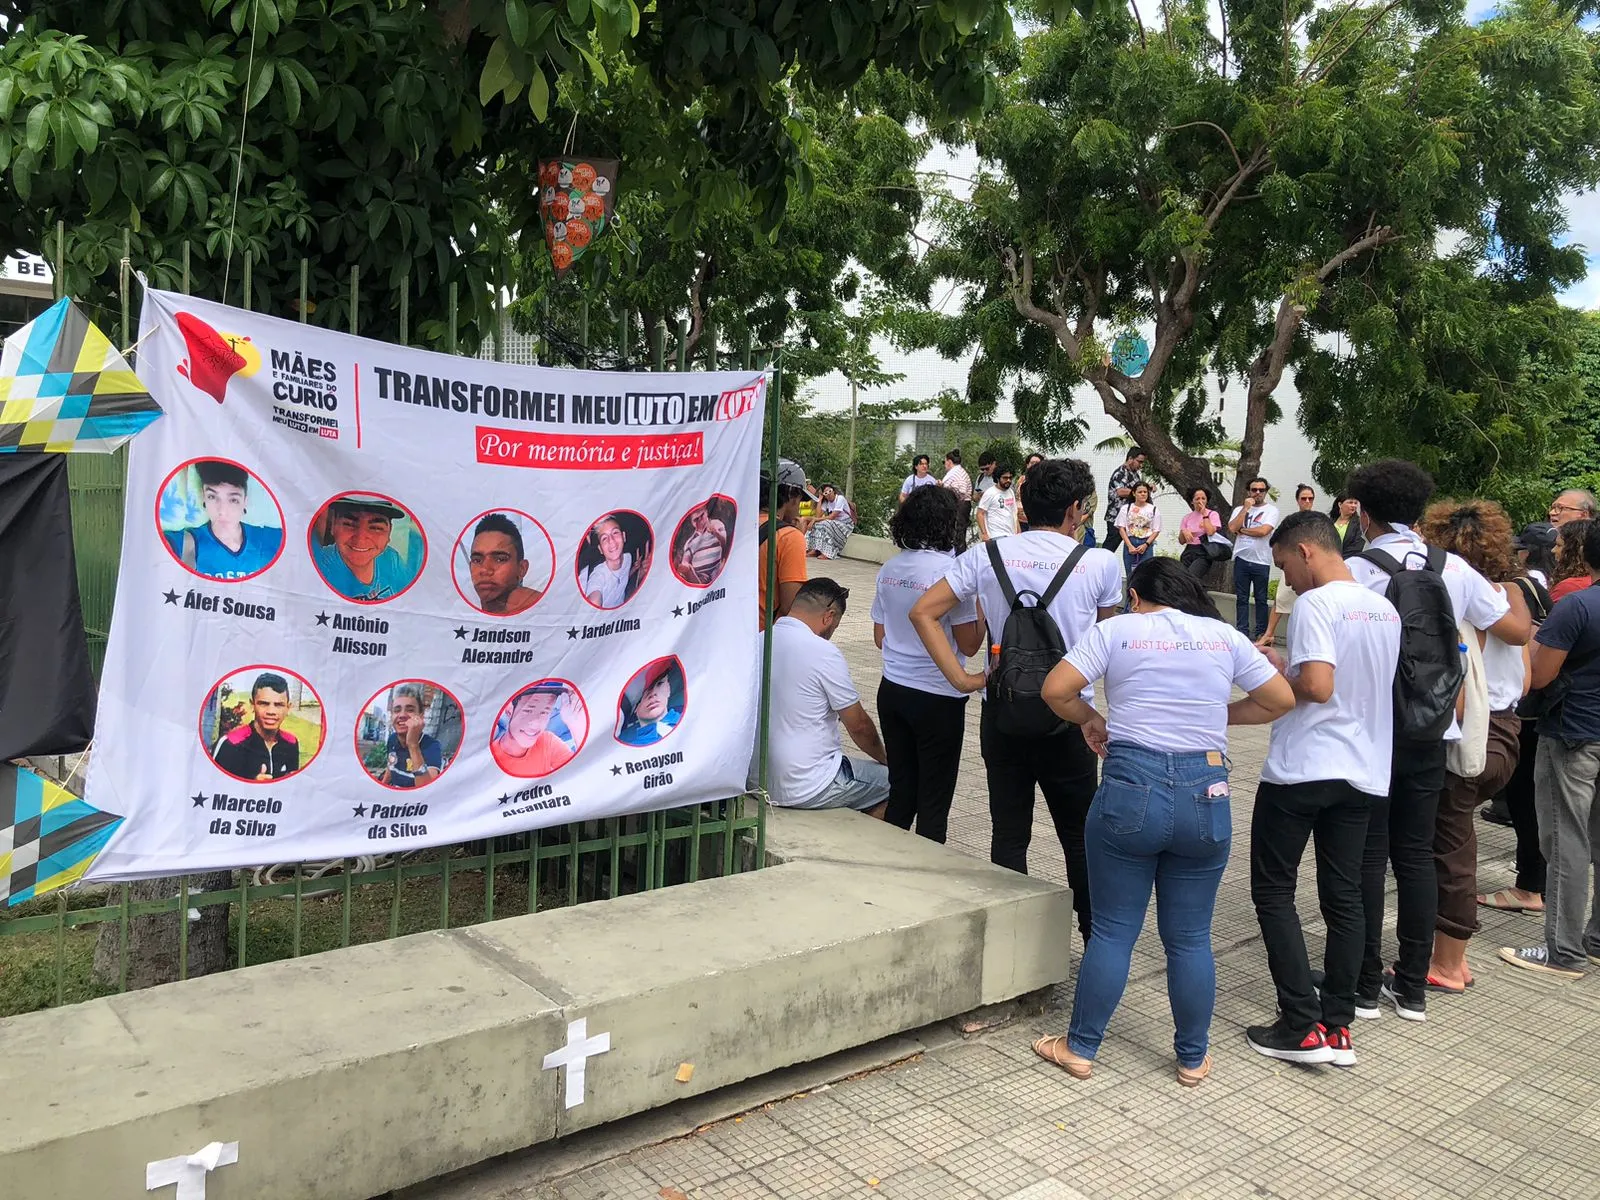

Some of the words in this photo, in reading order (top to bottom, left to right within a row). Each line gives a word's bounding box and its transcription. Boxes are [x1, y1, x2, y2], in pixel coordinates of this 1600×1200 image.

[271, 349, 336, 382] MÃES
[272, 371, 278, 379] E
[281, 373, 324, 390] FAMILIARES
[326, 383, 337, 392] DO
[374, 367, 565, 423] TRANSFORMEI
[572, 395, 622, 425] MEU
[626, 395, 684, 425] LUTO
[687, 395, 719, 424] EM
[272, 415, 287, 425] MEU
[289, 419, 307, 432] LUTO
[308, 426, 319, 434] EM
[320, 428, 338, 438] LUTA
[273, 405, 338, 428] TRANSFORMEI
[479, 433, 523, 459] Por
[528, 440, 616, 463] memória
[621, 446, 632, 462] e
[632, 437, 701, 470] justiça!
[183, 589, 220, 613] Álef
[222, 597, 276, 622] Sousa
[332, 613, 389, 635] Antônio
[581, 621, 615, 641] Jardel
[615, 618, 641, 633] Lima
[472, 627, 531, 644] Jandson
[332, 636, 388, 657] Alisson
[462, 648, 534, 664] Alexandre
[625, 751, 684, 775] Renayson
[643, 772, 674, 790] Girão
[211, 793, 283, 814] Marcelo
[370, 802, 428, 819] Patrício
[209, 818, 231, 835] da
[235, 819, 276, 837] Silva
[368, 825, 387, 840] da
[390, 823, 428, 839] Silva
